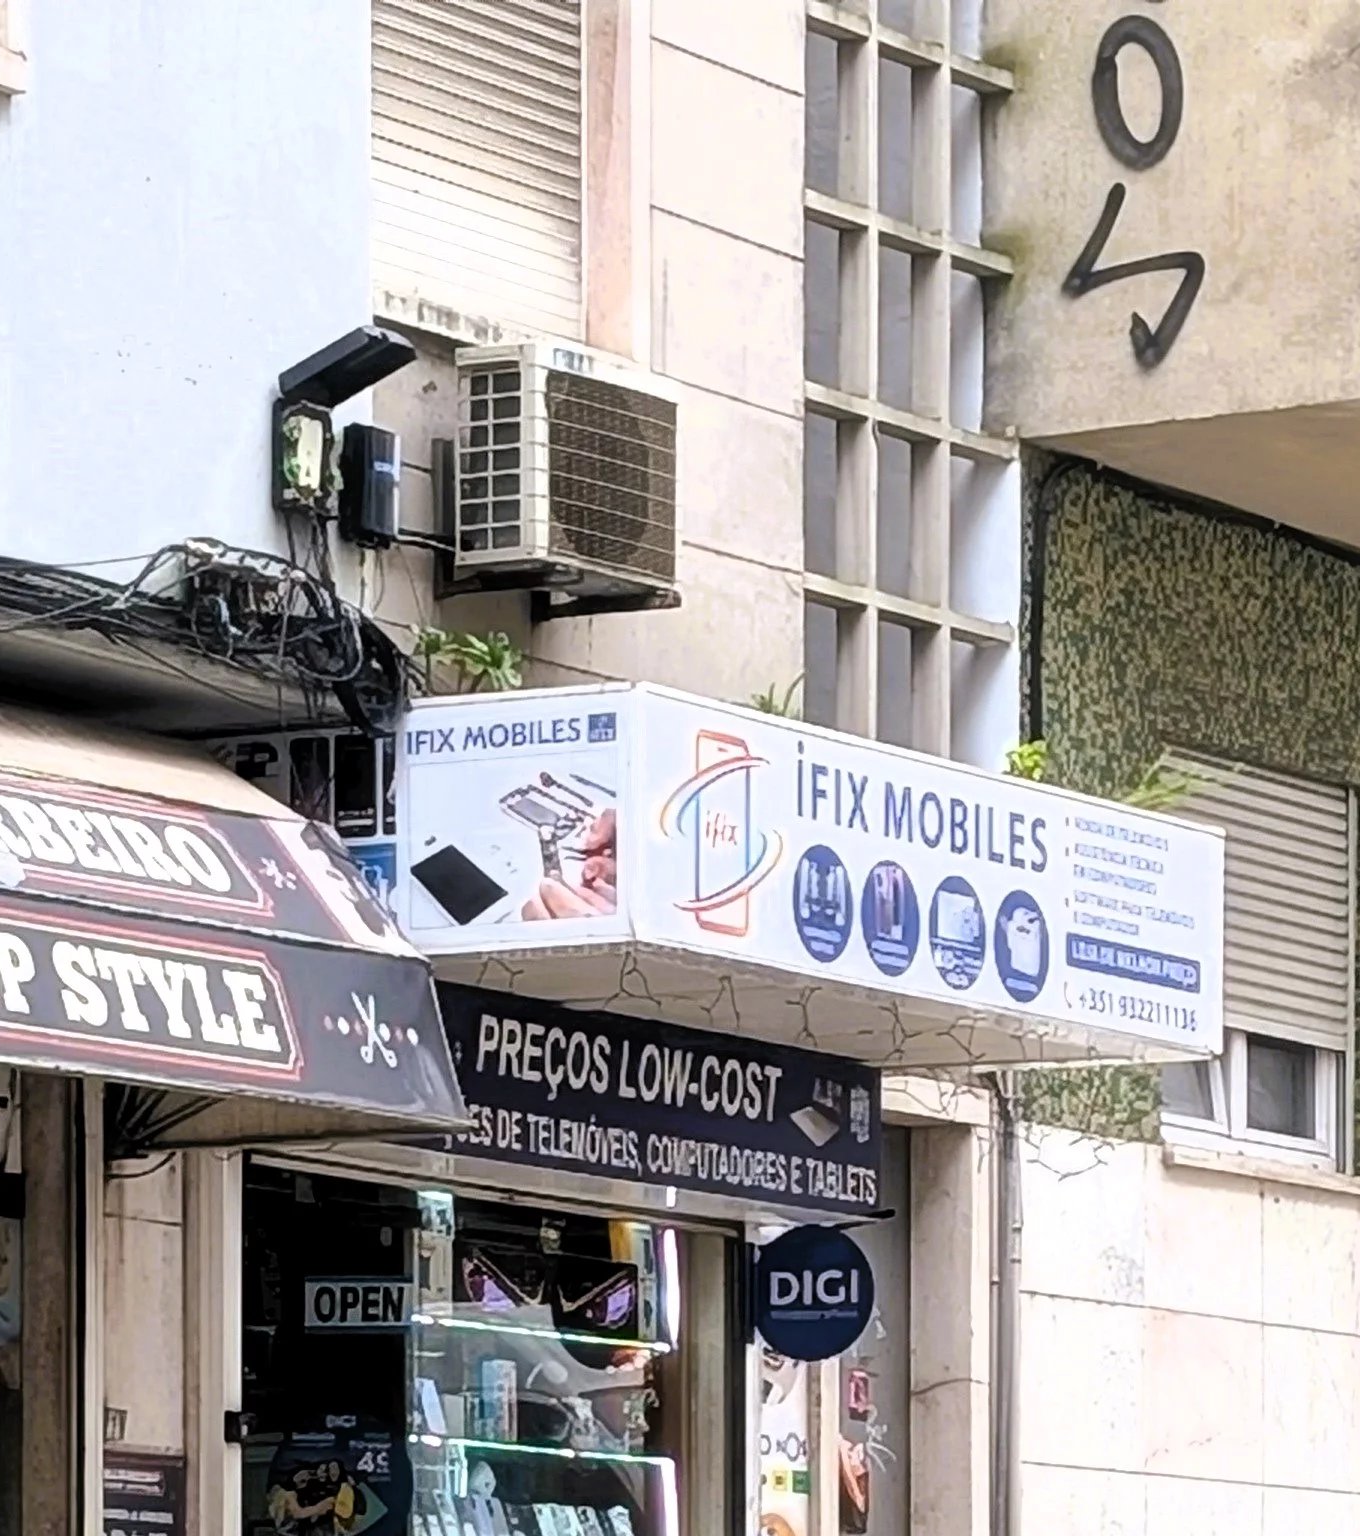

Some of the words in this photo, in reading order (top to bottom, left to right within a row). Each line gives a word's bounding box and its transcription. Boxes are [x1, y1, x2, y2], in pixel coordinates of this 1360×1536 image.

[407, 727, 455, 754] IFIX
[463, 717, 581, 752] MOBILES
[885, 782, 1049, 874] MOBILES
[60, 941, 282, 1053] STYLE
[1078, 987, 1114, 1016] +351
[475, 1013, 611, 1101] PREÇOS
[619, 1038, 783, 1122] LOW-COST
[497, 1109, 523, 1151] DE
[646, 1132, 788, 1192] COMPUTADORES
[790, 1155, 804, 1195] E
[805, 1158, 878, 1206] TABLETS
[313, 1283, 406, 1325] OPEN
[769, 1268, 860, 1306] DIGI
